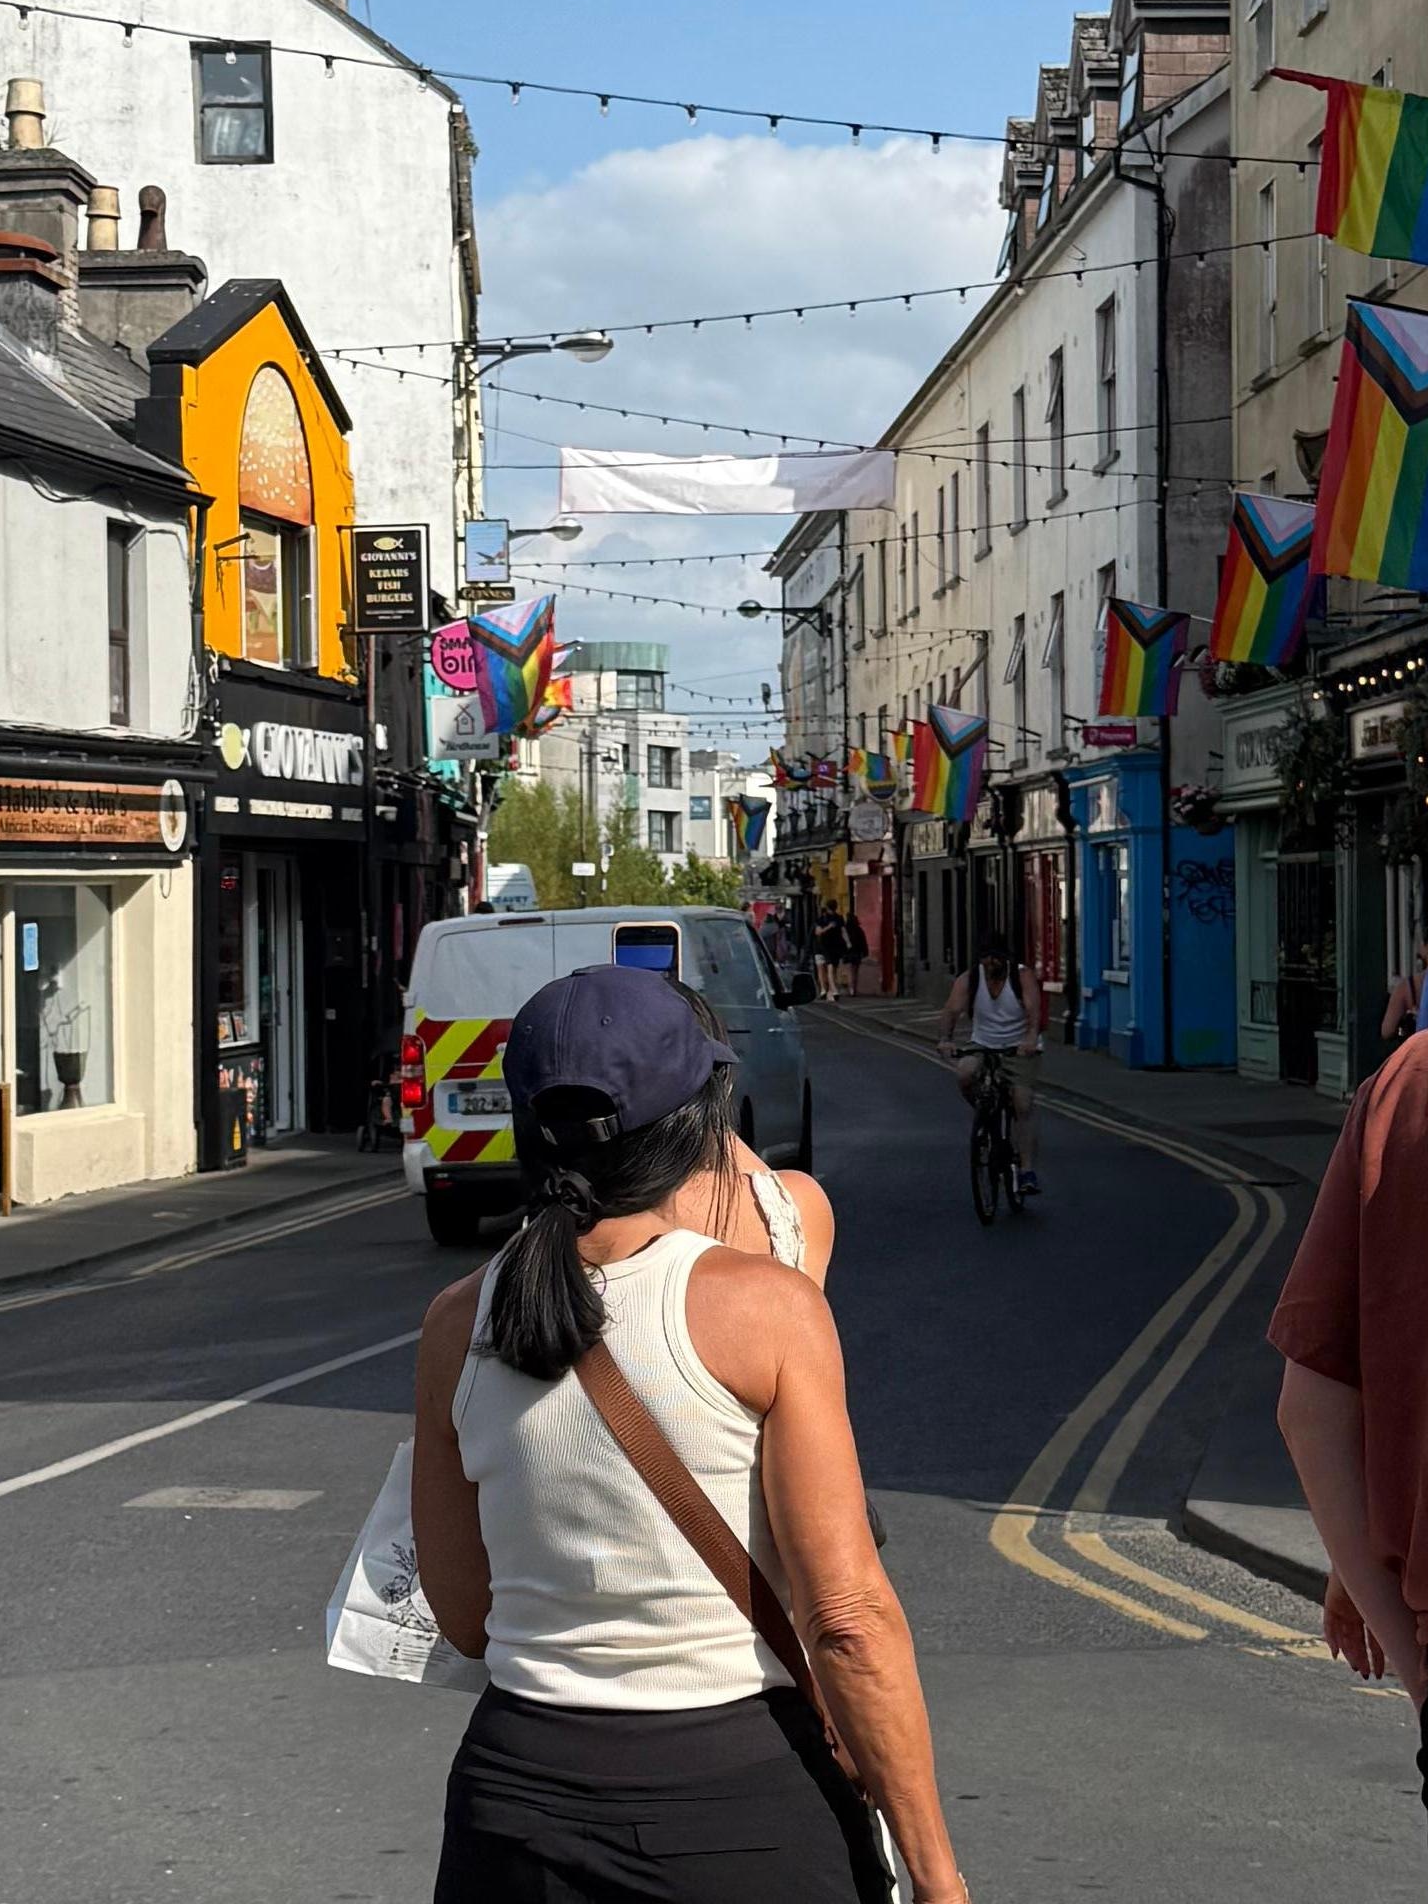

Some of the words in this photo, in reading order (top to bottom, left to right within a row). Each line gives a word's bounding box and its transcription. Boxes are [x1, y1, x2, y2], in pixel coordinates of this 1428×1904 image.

[360, 552, 417, 562] GIOVANNI'S
[369, 568, 409, 578] KEBABS
[377, 581, 401, 590] FISH
[365, 593, 413, 603] BURGERS
[252, 721, 363, 786] GIOVANNI'S
[65, 789, 80, 815] &
[83, 786, 128, 817] Abu's
